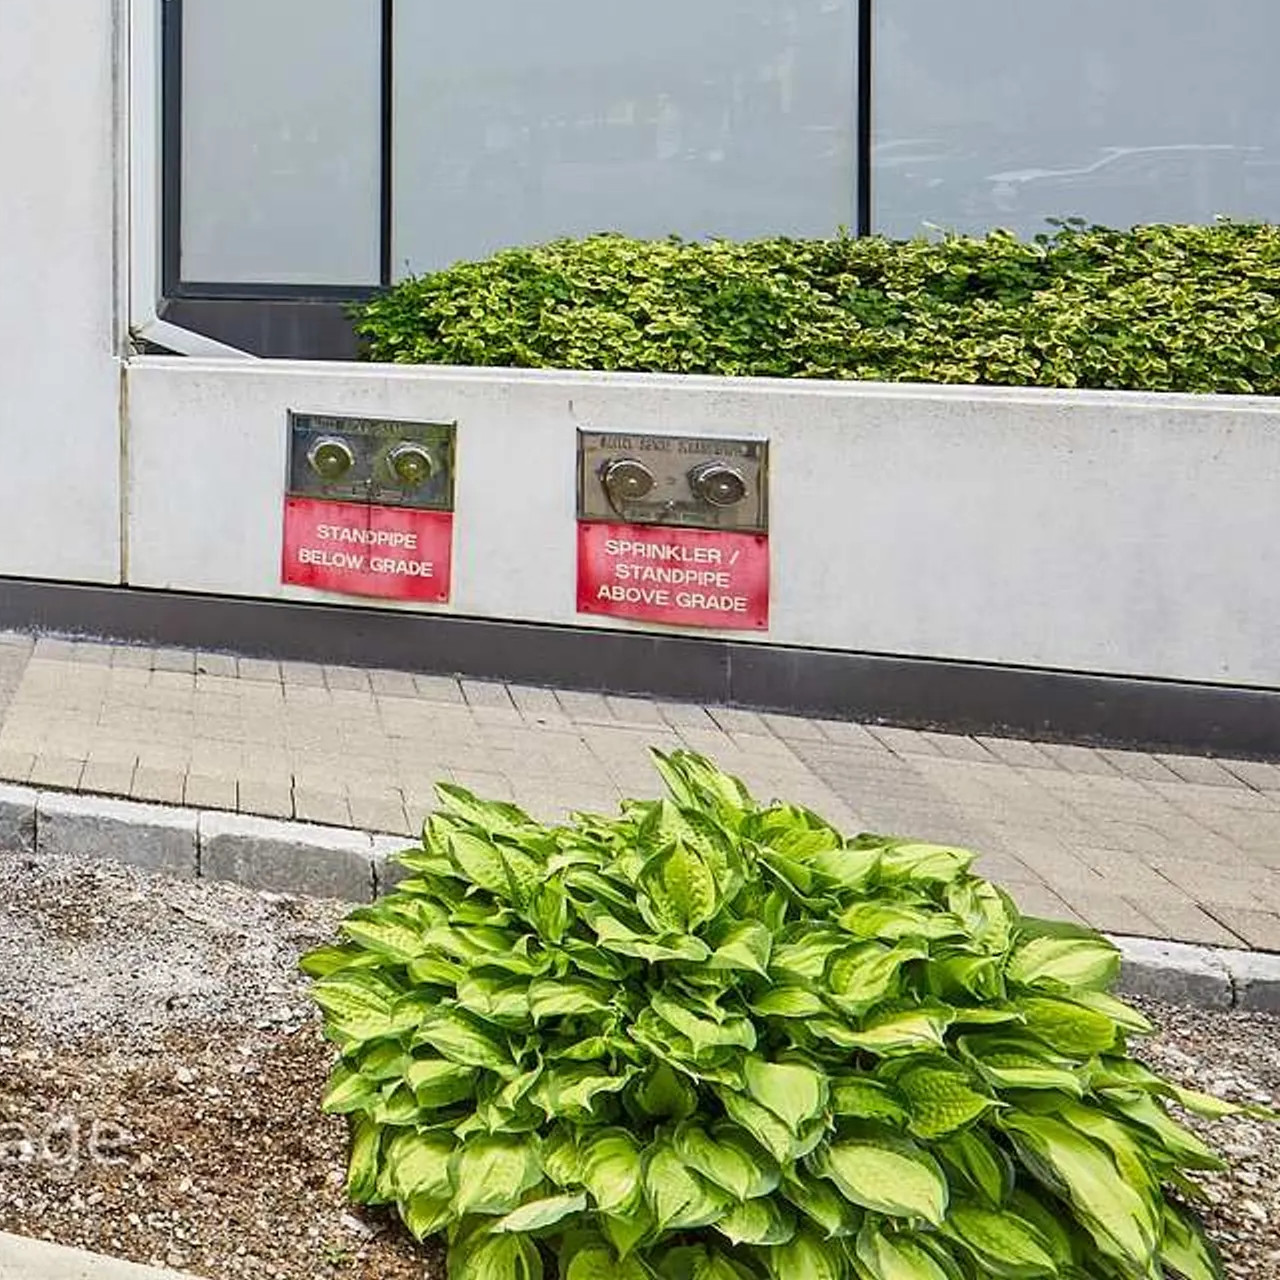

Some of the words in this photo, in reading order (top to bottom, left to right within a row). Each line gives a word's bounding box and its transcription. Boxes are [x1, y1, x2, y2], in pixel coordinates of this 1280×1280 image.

[316, 524, 418, 550] STANDPIPE
[298, 548, 365, 570] BELOW
[369, 556, 434, 578] GRADE
[605, 539, 722, 565] SPRINKLER
[728, 549, 741, 566] /
[615, 563, 731, 588] STANDPIPE
[596, 584, 671, 606] ABOVE
[675, 591, 749, 612] GRADE
